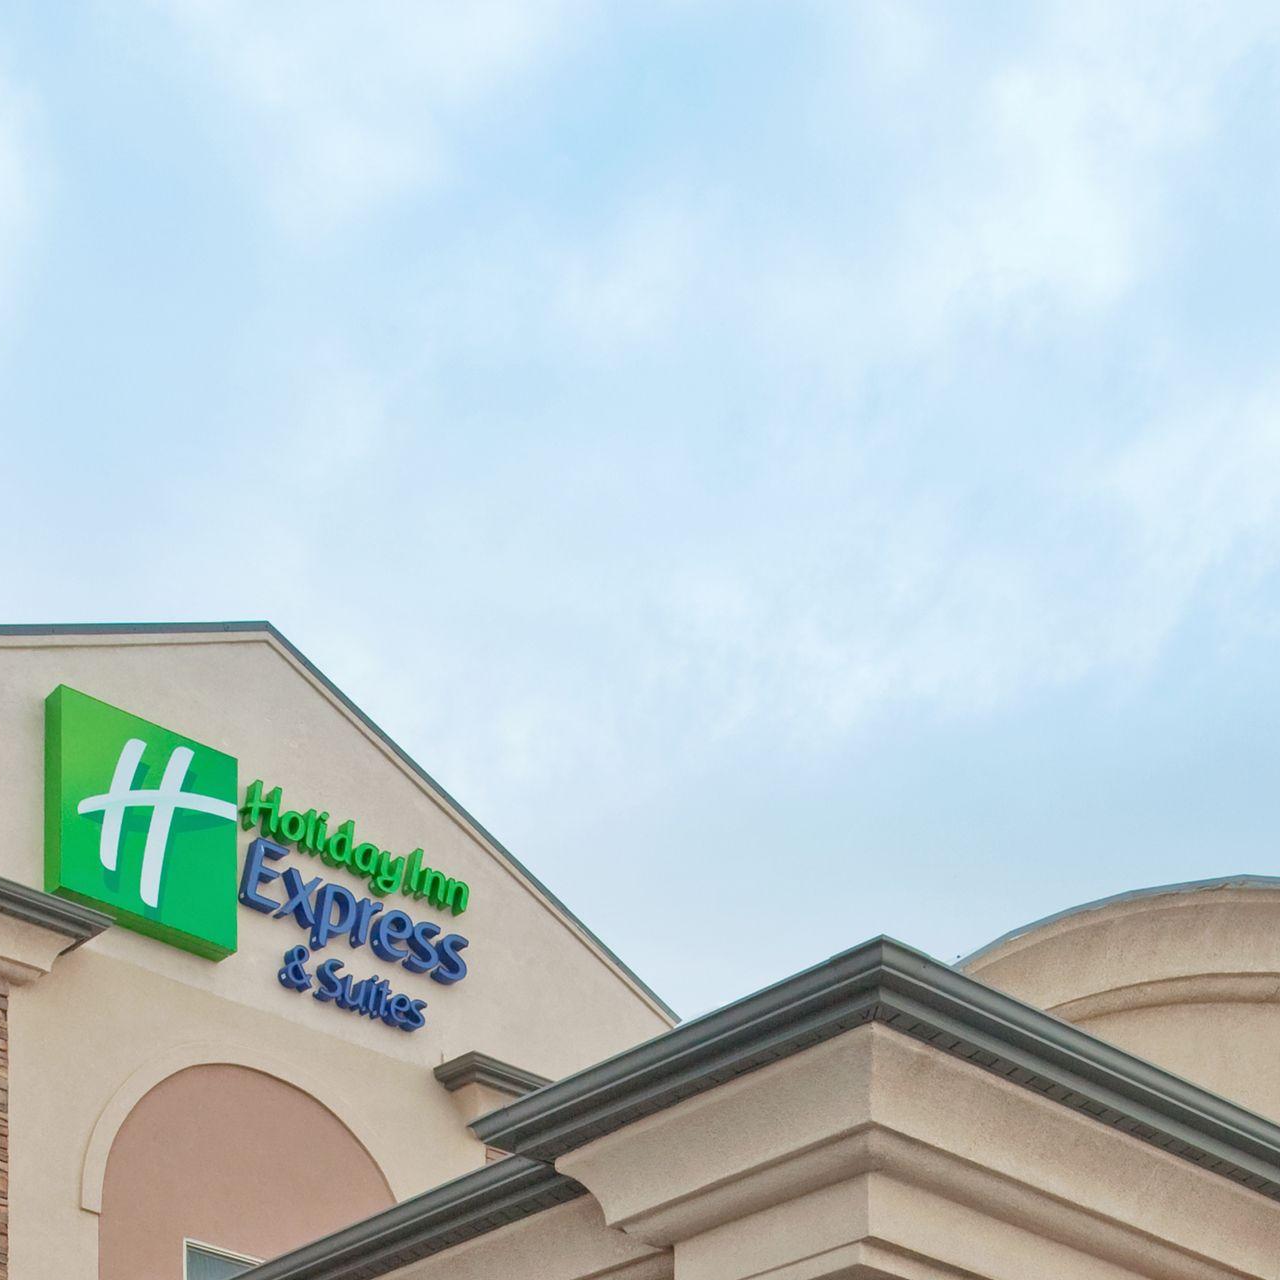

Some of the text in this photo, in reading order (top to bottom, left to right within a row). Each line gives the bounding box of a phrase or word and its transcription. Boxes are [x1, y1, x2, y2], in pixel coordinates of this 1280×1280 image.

[238, 837, 469, 985] Express
[278, 944, 427, 1032] & Suites
